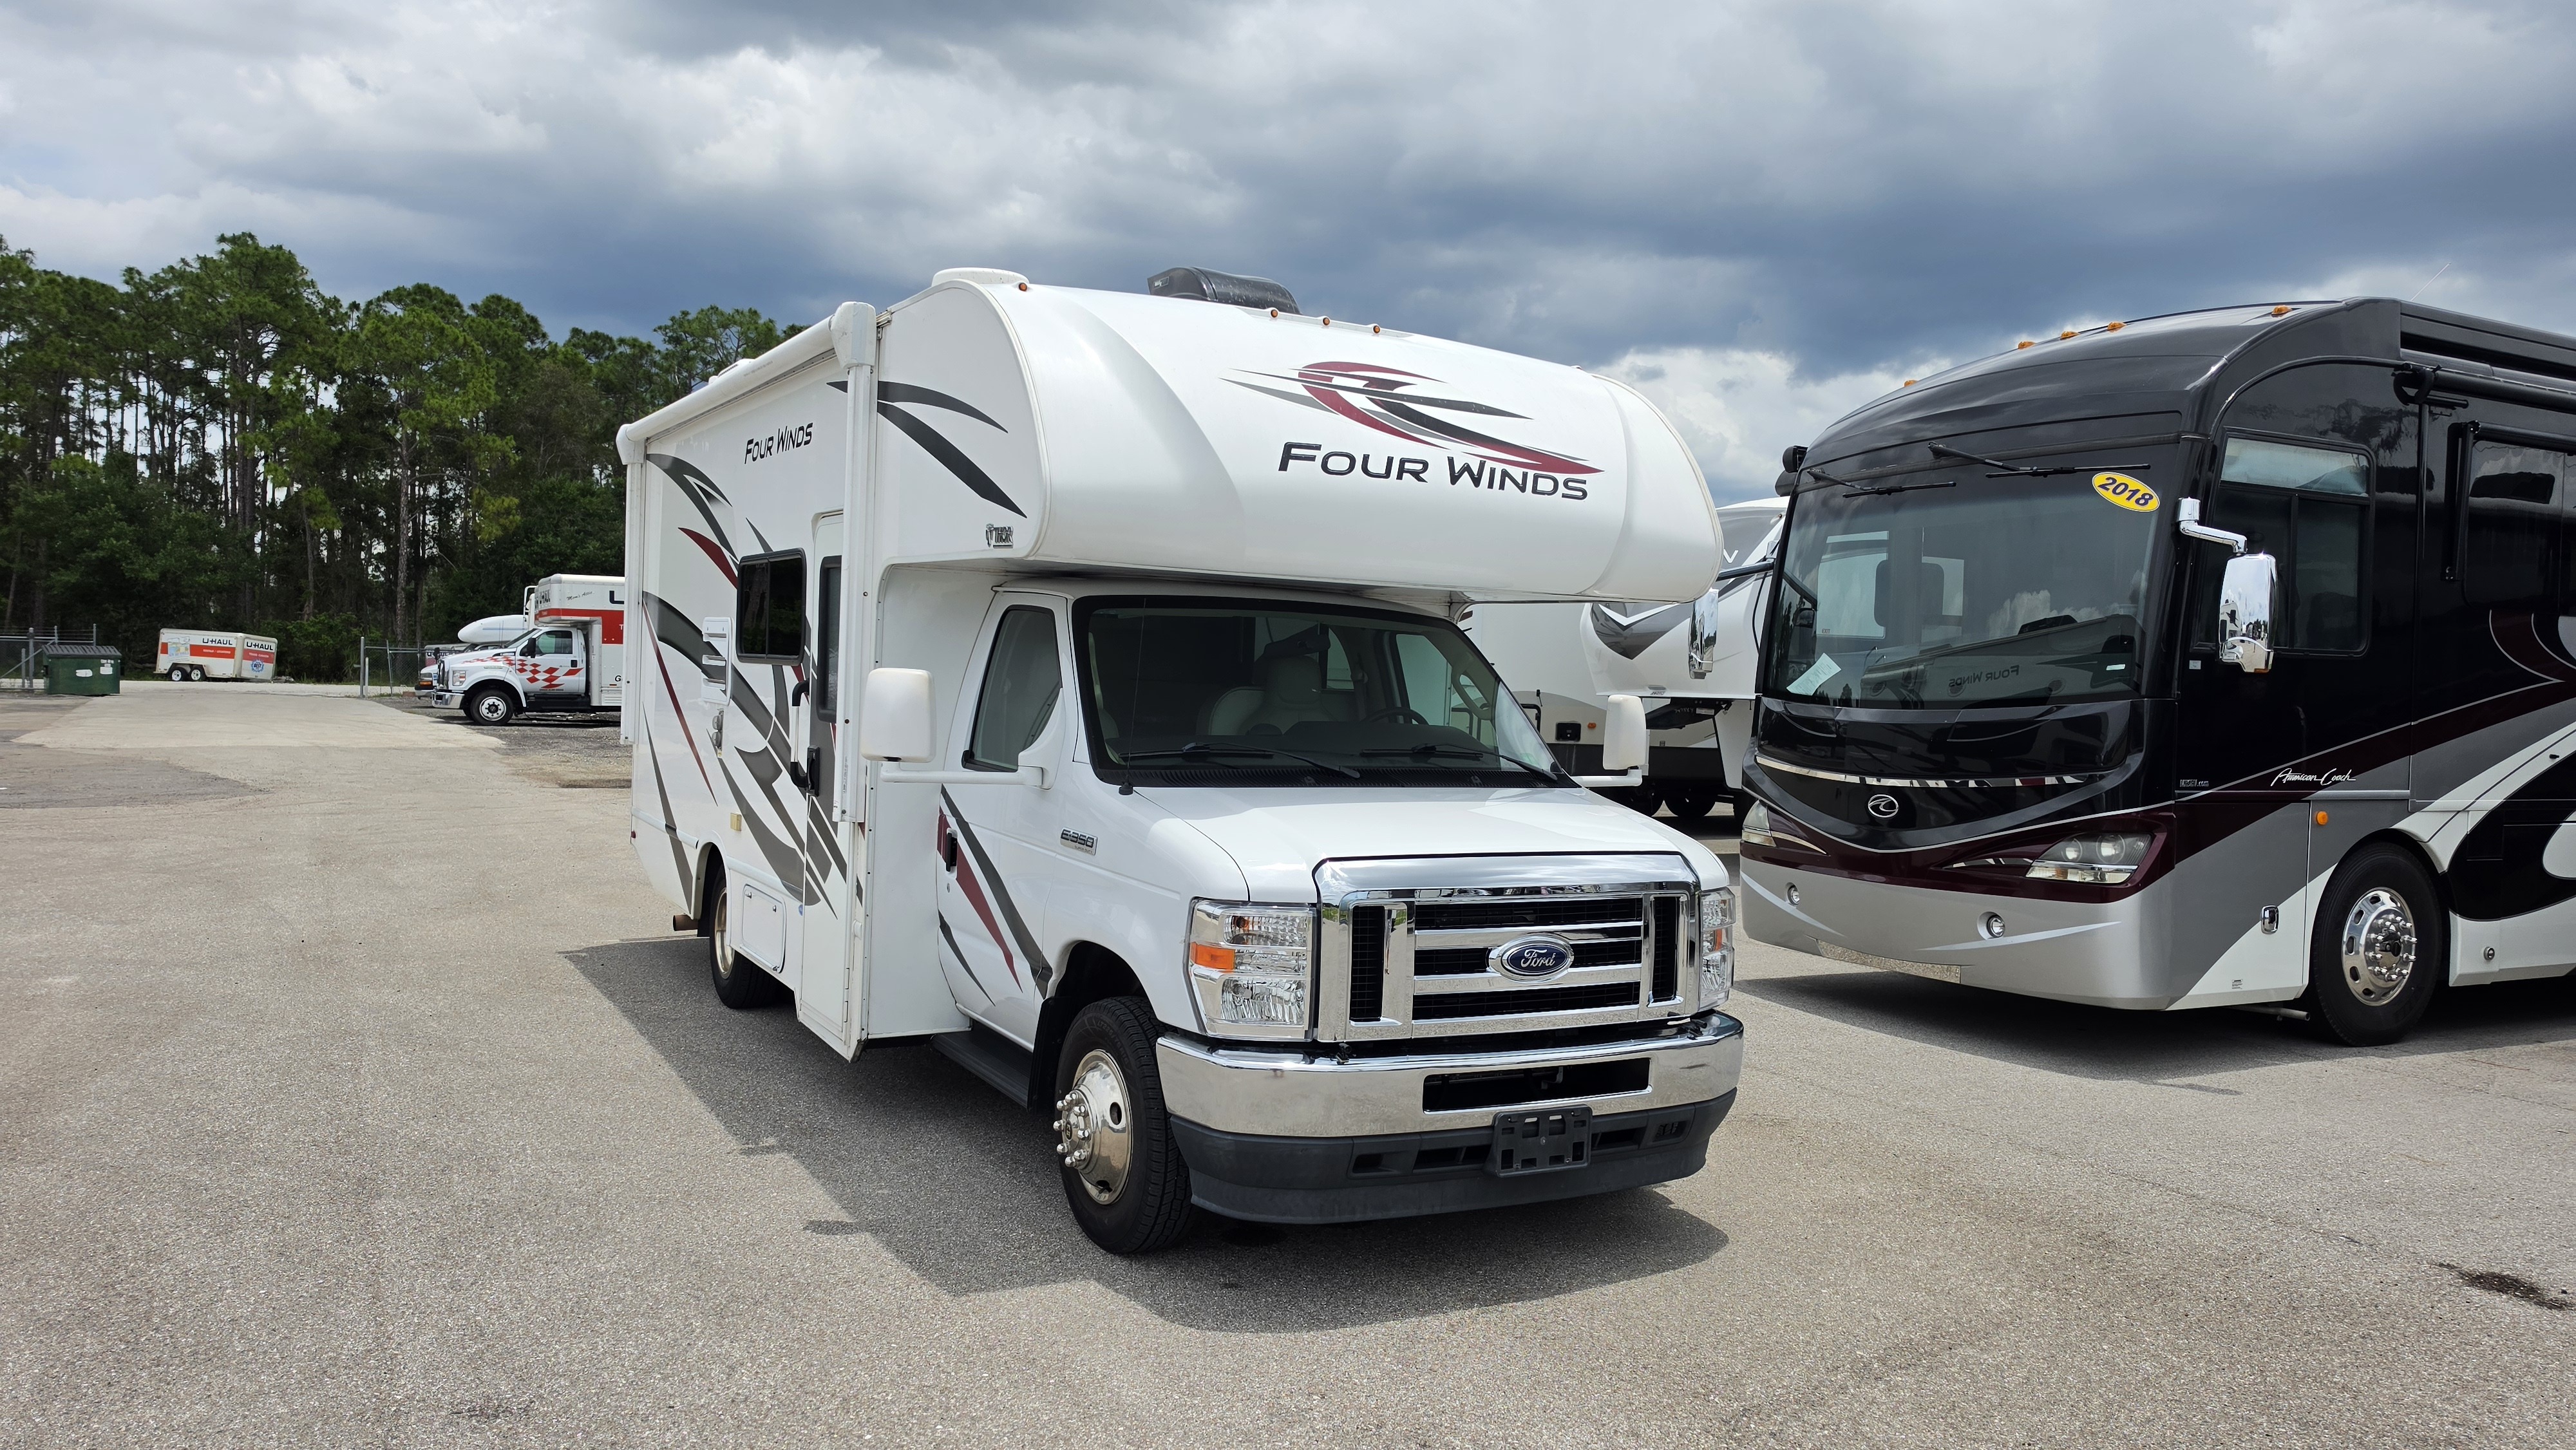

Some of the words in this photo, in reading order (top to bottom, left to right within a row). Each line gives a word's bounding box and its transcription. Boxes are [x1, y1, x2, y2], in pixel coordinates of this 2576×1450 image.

[744, 436, 773, 464] FOUR
[777, 422, 813, 454] WINDS
[1278, 442, 1429, 483] FOUR
[1447, 456, 1588, 500] WINDS
[2098, 477, 2154, 506] 2018
[992, 526, 1013, 543] THOR
[247, 641, 274, 650] U-HAUL
[2270, 767, 2321, 786] American
[2320, 767, 2356, 786] Coach
[1061, 829, 1094, 848] E-350
[1520, 949, 1557, 967] Ford
